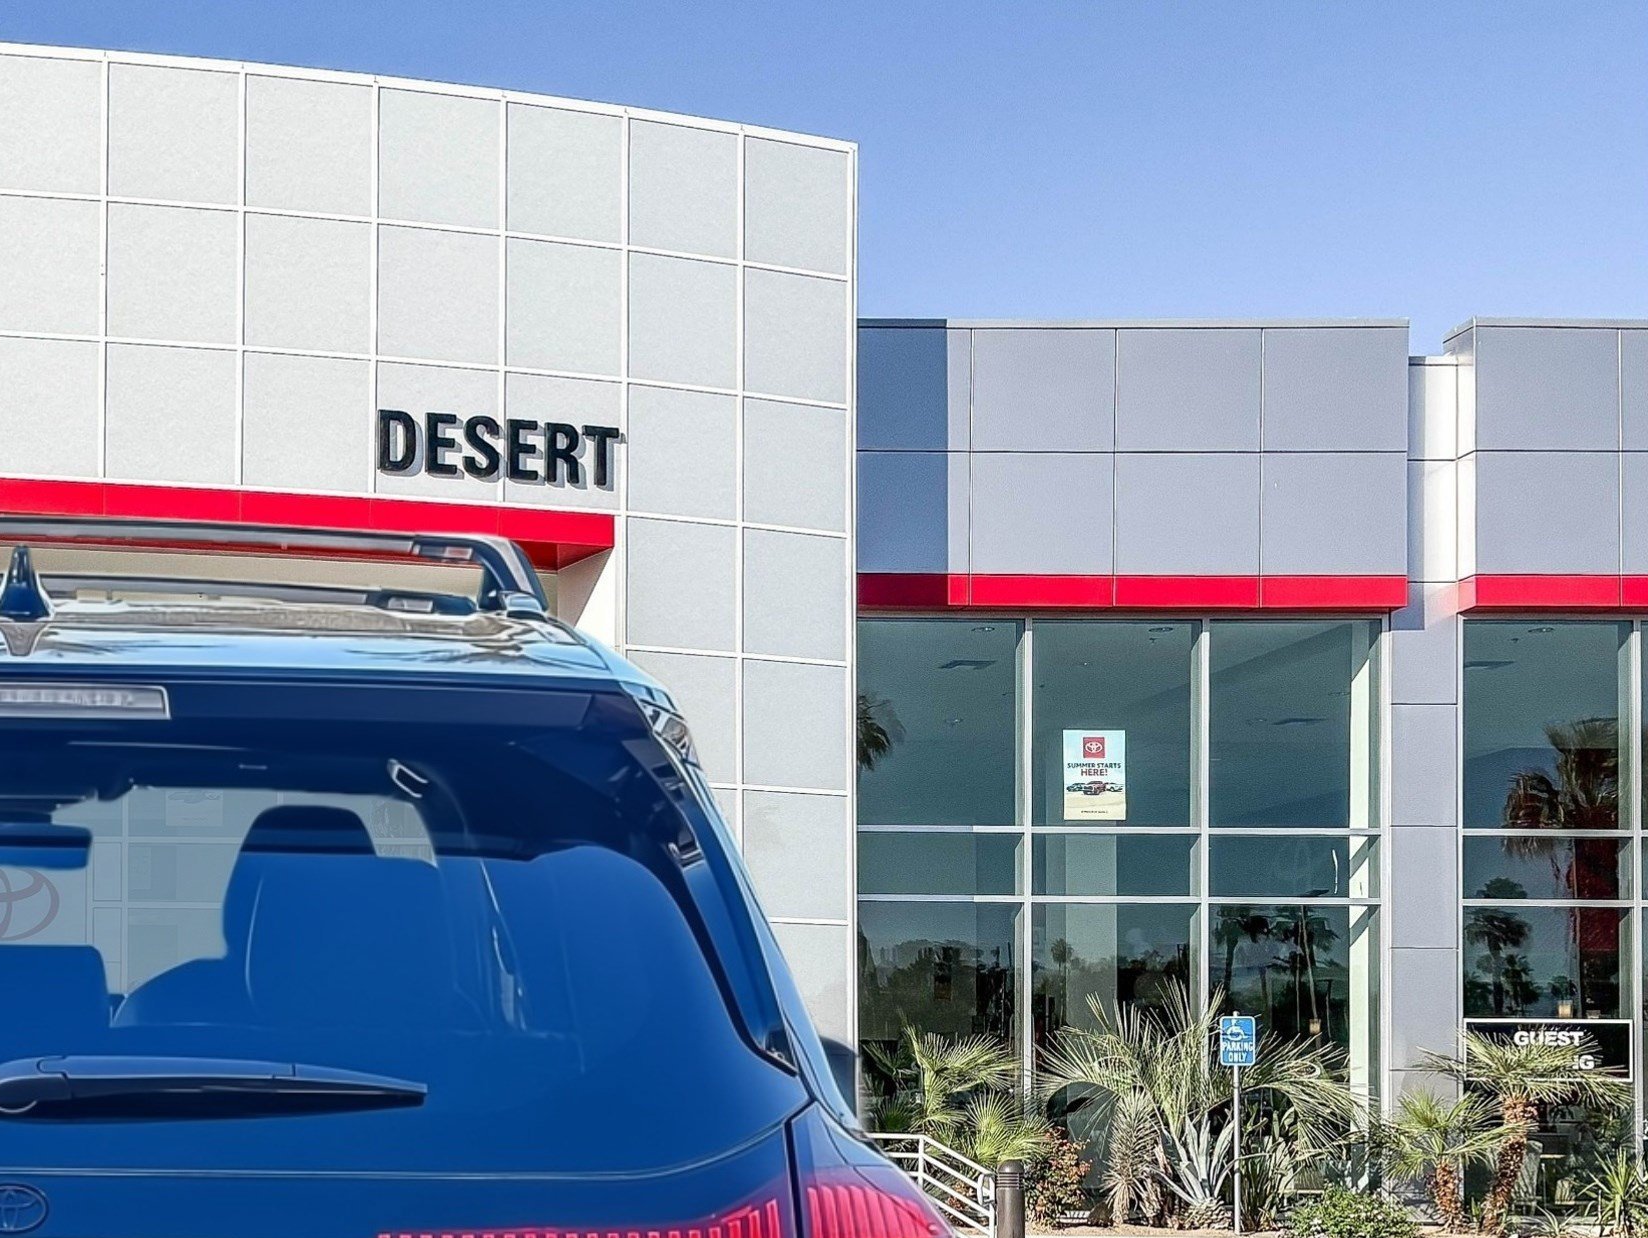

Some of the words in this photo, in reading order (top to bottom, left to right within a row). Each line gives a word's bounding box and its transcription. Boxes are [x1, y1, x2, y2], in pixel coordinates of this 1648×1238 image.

[377, 409, 620, 487] DESERT
[1080, 768, 1108, 777] HERE!
[1513, 1030, 1584, 1047] GUEST
[1222, 1041, 1253, 1051] PARKING
[1228, 1052, 1248, 1062] ONLY
